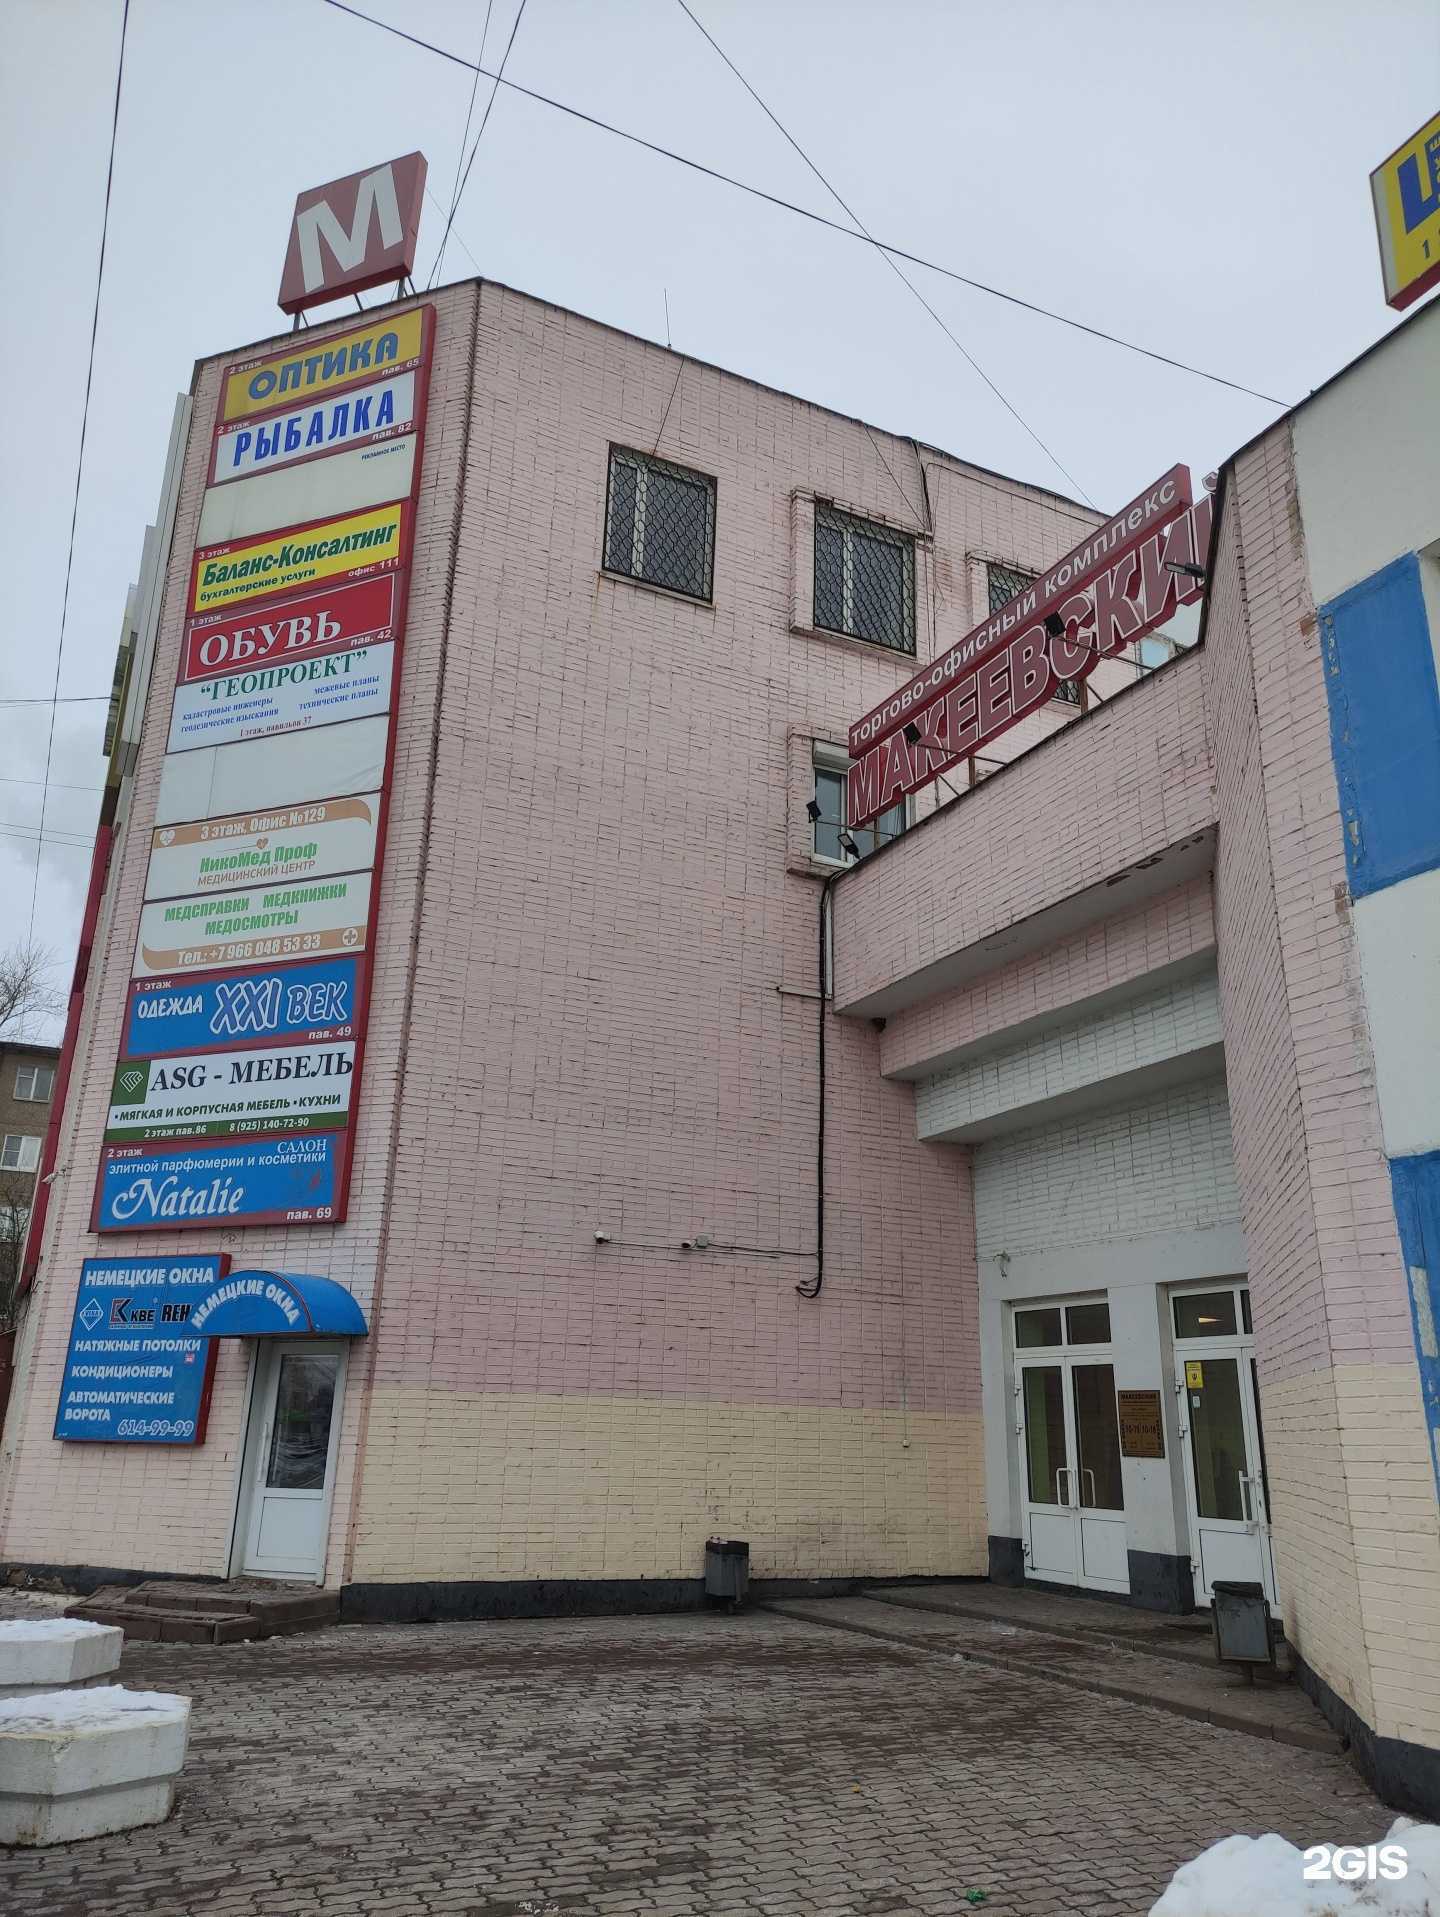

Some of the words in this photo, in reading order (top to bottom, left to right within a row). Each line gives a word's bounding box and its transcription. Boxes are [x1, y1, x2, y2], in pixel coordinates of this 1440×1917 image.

[297, 163, 404, 293] М
[229, 366, 236, 375] 2
[237, 360, 263, 373] этаж
[248, 332, 399, 400] ОПТИКА
[382, 365, 403, 376] пав.
[406, 357, 419, 368] 65
[217, 425, 224, 434] 2
[227, 420, 250, 432] этаж
[233, 390, 394, 467] РЫБАЛКА
[372, 429, 395, 441] пав.
[398, 422, 412, 433] 82
[390, 443, 406, 454] МЕСТО
[200, 551, 206, 560] 3
[207, 547, 230, 559] этаж
[203, 524, 397, 586] Баланс-Консалтинг
[348, 565, 374, 577] офис
[379, 558, 399, 570] 111
[200, 577, 278, 601] бухгалтерские
[281, 568, 316, 585] услуги
[190, 618, 196, 627] 1
[199, 614, 221, 625] этаж
[850, 589, 1037, 746] торгово-офисный
[1043, 479, 1176, 599] комплекс
[200, 611, 341, 666] ОБУВЬ
[350, 636, 373, 647] пав.
[314, 680, 350, 695] межевые
[352, 674, 380, 688] планы
[182, 703, 232, 720] кадастровые
[233, 696, 273, 712] инженеры
[299, 693, 350, 711] технические
[351, 687, 379, 702] планы
[181, 715, 235, 733] геодезические
[236, 707, 279, 723] изыскания
[266, 719, 301, 733] павильон
[303, 715, 313, 725] 37
[201, 824, 209, 839] 3
[250, 814, 287, 832] Офис
[289, 807, 325, 826] №129
[200, 849, 270, 873] НикоМед
[274, 842, 317, 862] Проф
[198, 864, 278, 886] МЕДИЦИНСКИЙ
[281, 860, 316, 875] ЦЕНТР
[164, 898, 250, 921] МЕДСПРАВКИ
[263, 883, 347, 908] МЕДКНИЖКИ
[205, 910, 298, 935] МЕДОСМОТРЫ
[177, 950, 206, 965] Тел.:
[209, 946, 224, 961] +7
[226, 943, 252, 958] 966
[255, 939, 281, 956] 048
[283, 936, 300, 952] 53
[303, 934, 320, 950] 33
[136, 983, 141, 991] 1
[143, 980, 171, 990] этаж
[137, 995, 203, 1019] ОДЕЖДА
[287, 980, 348, 1024] ВЕК
[308, 1030, 333, 1040] пав.
[337, 1026, 351, 1037] 49
[151, 1065, 207, 1092] ASG
[229, 1051, 353, 1084] МЕБЕЛЬ
[120, 1109, 163, 1121] МЯГКАЯ
[165, 1107, 173, 1117] И
[176, 1102, 244, 1116] КОРПУСНАЯ
[246, 1099, 290, 1111] МЕБЕЛЬ
[298, 1094, 341, 1107] КУХНИ
[144, 1128, 150, 1137] 2
[151, 1127, 174, 1137] этаж
[229, 1122, 235, 1132] 8
[237, 1120, 261, 1132] (925)
[263, 1117, 309, 1130] 140-72-90
[107, 1149, 114, 1158] 2
[116, 1147, 143, 1158] этаж
[277, 1139, 327, 1154] САЛОН
[109, 1160, 158, 1175] элитной
[161, 1155, 244, 1171] парфюмерии
[247, 1157, 255, 1166] и
[258, 1152, 326, 1166] косметики
[111, 1176, 246, 1220] Natalie
[287, 1209, 312, 1221] пав.
[316, 1207, 332, 1219] 69
[85, 1268, 167, 1288] НЕМЕЦКИЕ
[170, 1267, 214, 1285] ОКНА
[191, 1279, 264, 1329] НЕМЕЦКИЕ
[265, 1283, 300, 1326] ОКНА
[130, 1309, 155, 1322] KBE
[75, 1339, 140, 1352] НАТЯЖНЫЕ
[142, 1338, 201, 1352] ПОТОЛКИ
[71, 1365, 173, 1379] КОНДИЦИОНЕРЫ
[66, 1391, 175, 1404] АВТОМАТИЧЕСКИЕ
[64, 1408, 111, 1421] ВОРОТА
[117, 1418, 194, 1437] 614-99-99
